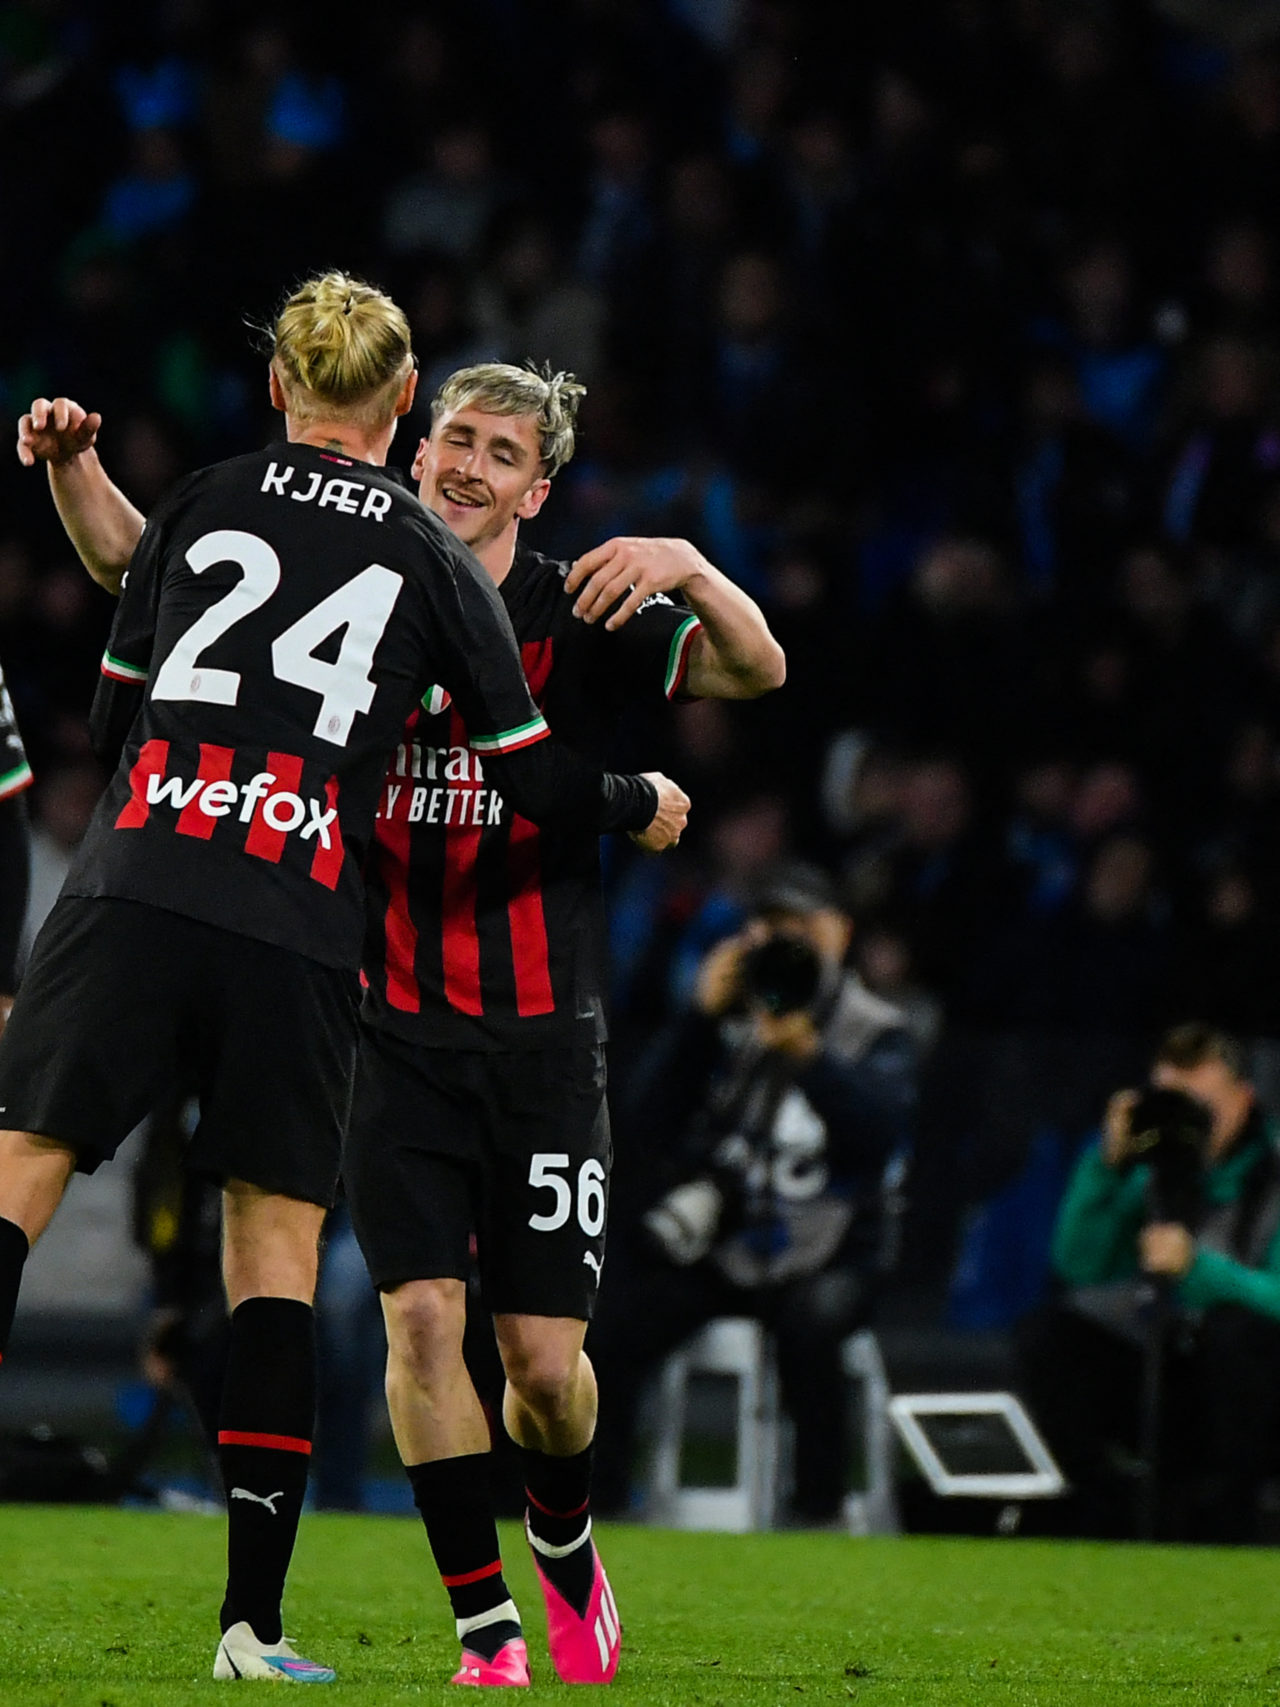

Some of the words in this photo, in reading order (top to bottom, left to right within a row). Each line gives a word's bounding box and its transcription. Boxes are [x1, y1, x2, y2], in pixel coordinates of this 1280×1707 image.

[260, 462, 393, 523] KJÆR
[150, 529, 404, 747] 24
[146, 772, 338, 850] wefox
[407, 786, 504, 825] BETTER
[528, 1153, 605, 1237] 56
